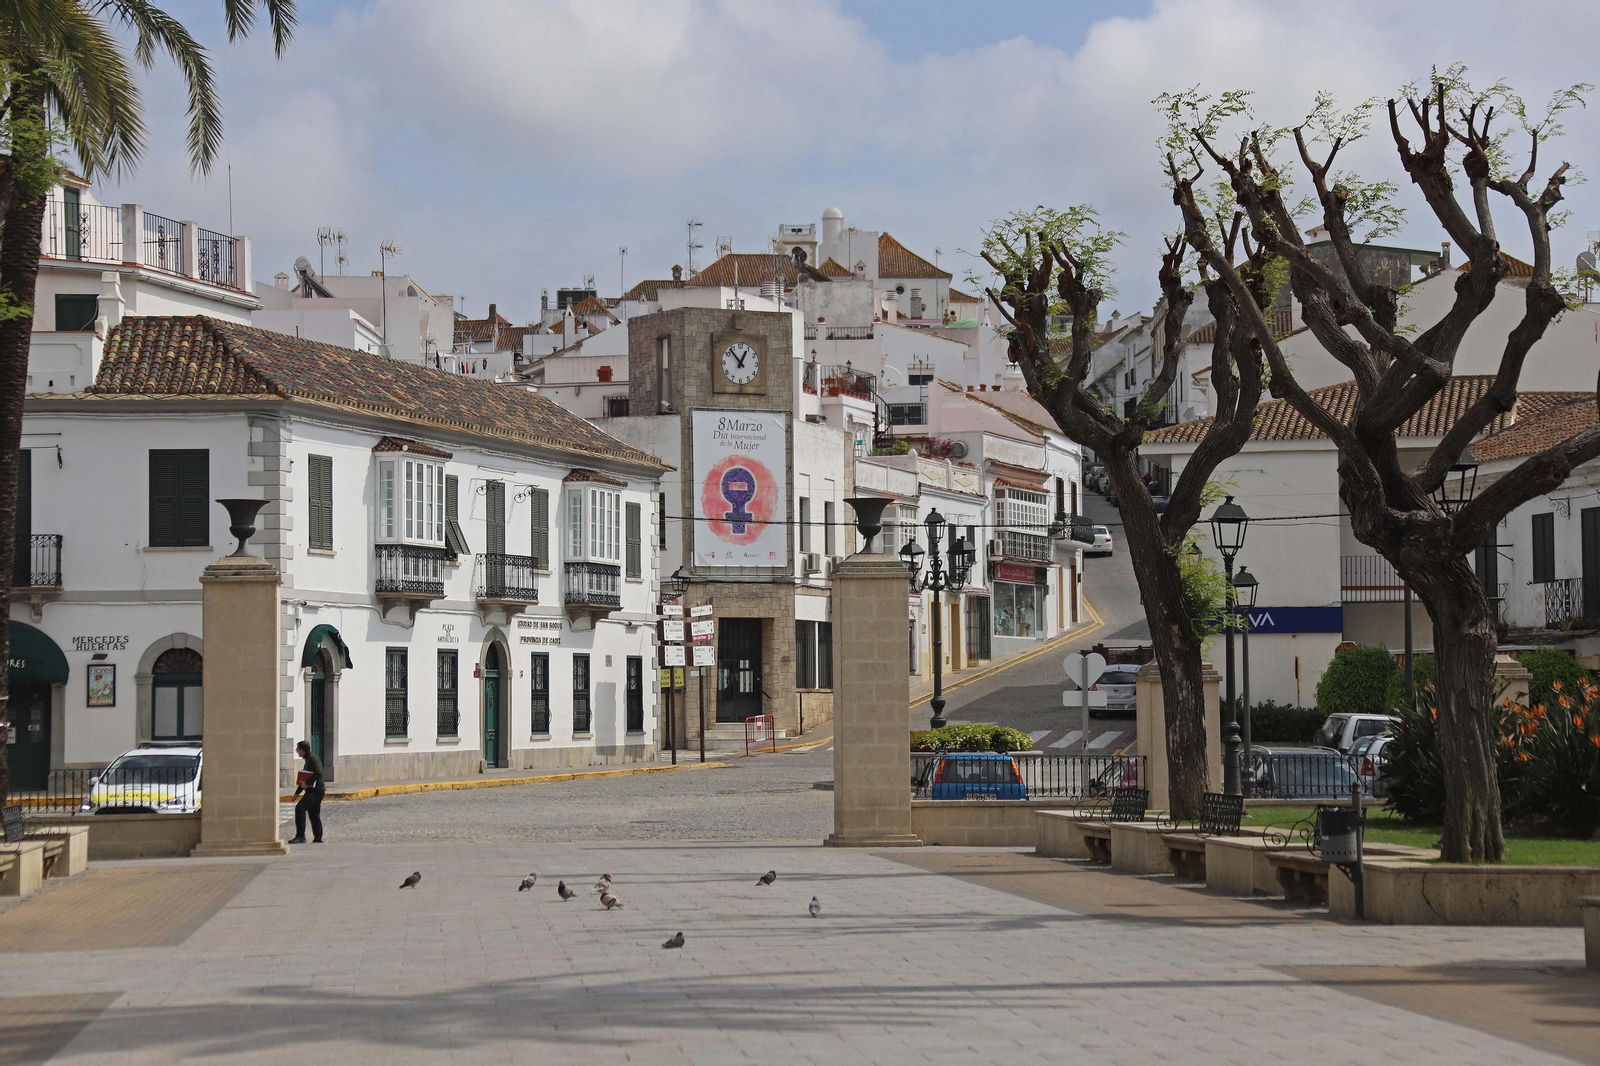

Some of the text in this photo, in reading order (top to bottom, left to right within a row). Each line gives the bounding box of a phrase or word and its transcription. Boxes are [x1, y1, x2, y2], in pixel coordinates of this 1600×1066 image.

[718, 416, 762, 431] 8 Marzo
[734, 441, 760, 452] Mujer
[1224, 612, 1274, 628] VA
[72, 636, 129, 644] MERCEDES
